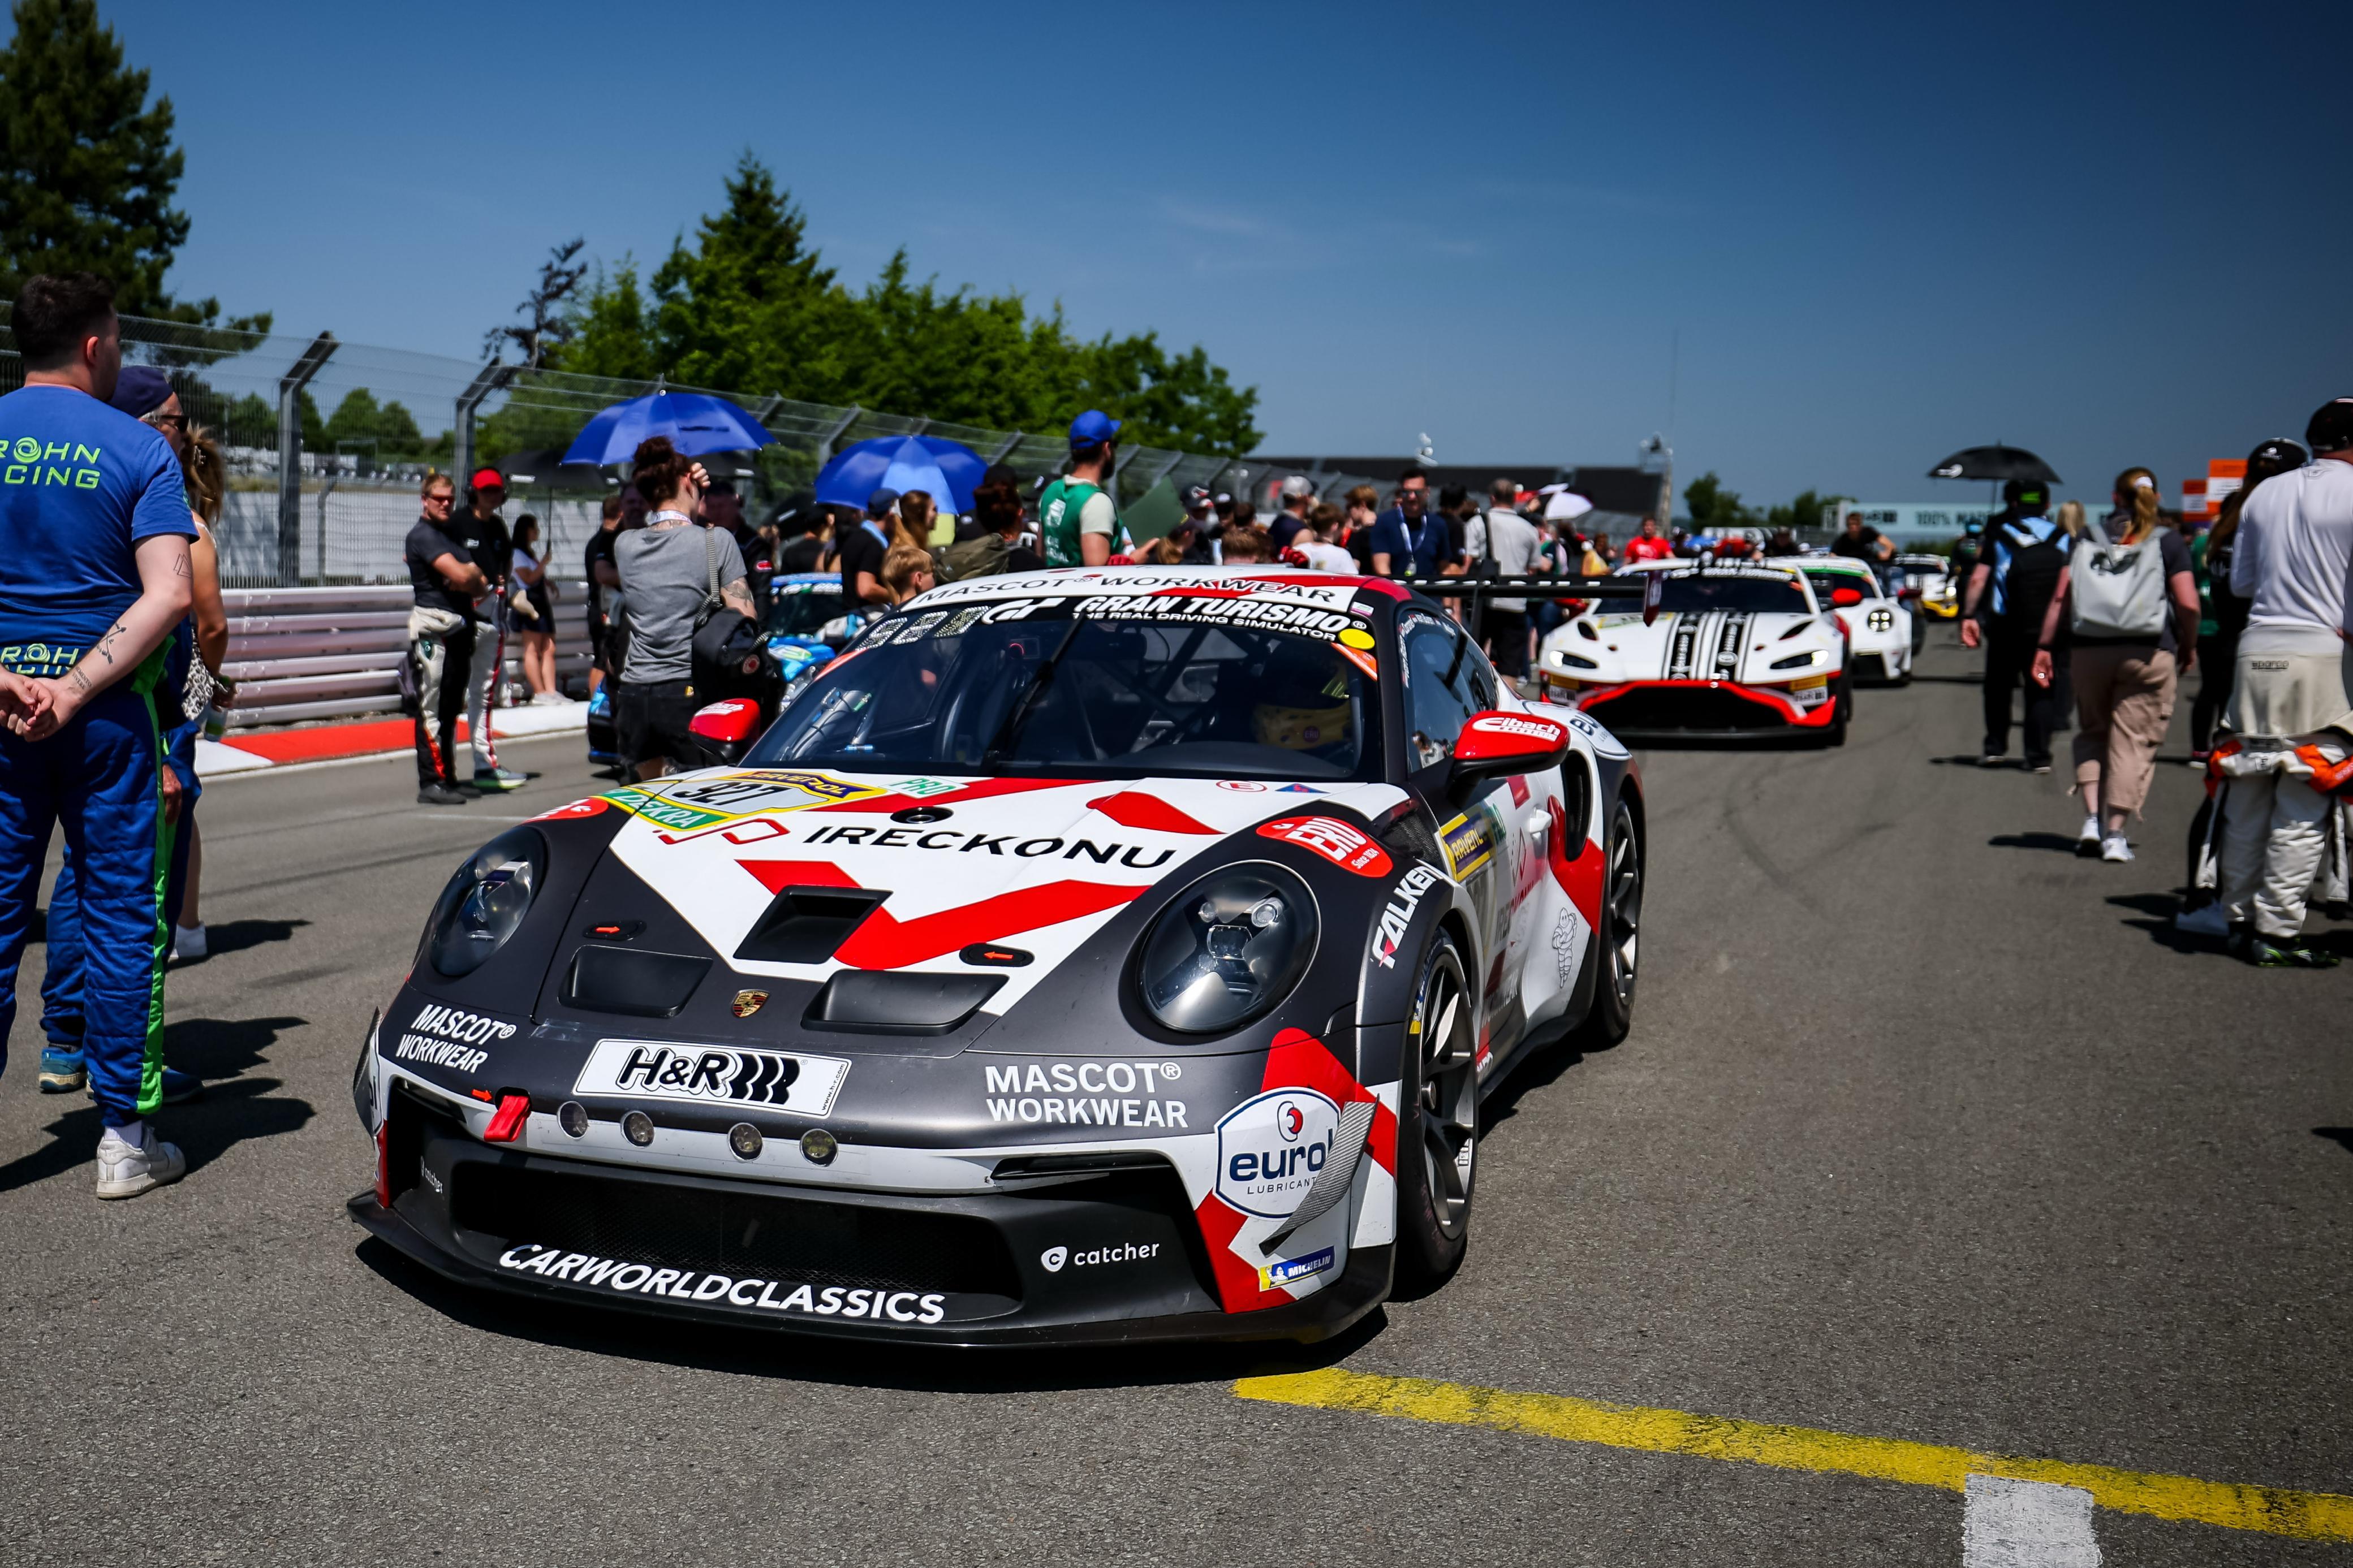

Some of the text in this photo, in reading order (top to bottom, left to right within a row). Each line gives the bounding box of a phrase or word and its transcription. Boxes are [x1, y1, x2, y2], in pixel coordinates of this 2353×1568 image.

[1100, 576, 1337, 603] WORKWEAR
[1074, 596, 1178, 613] GRAN
[1109, 612, 1158, 621] REAL
[1159, 613, 1229, 625] DRIVING
[1232, 618, 1337, 642] SIMULATOR
[1, 642, 79, 665] ROH
[1472, 717, 1561, 737] Eibach
[671, 781, 793, 806] 927
[749, 772, 847, 794] RAVENOL
[889, 778, 956, 794] PRO
[613, 793, 708, 828] DEKRA
[803, 826, 1178, 869] IRECKONU
[1285, 818, 1367, 862] ERU
[1351, 854, 1369, 869] Since
[1372, 866, 1443, 969] FALKEN
[395, 1034, 488, 1073] WORKWEAR
[615, 1046, 738, 1097] H&R
[822, 1064, 845, 1111] www.h-r.com
[985, 1098, 1189, 1129] WORKWEAR
[1074, 1242, 1160, 1266] catcher
[1288, 1255, 1331, 1278] MICHELIN
[499, 1244, 946, 1324] CARWORLDCLASSICS
